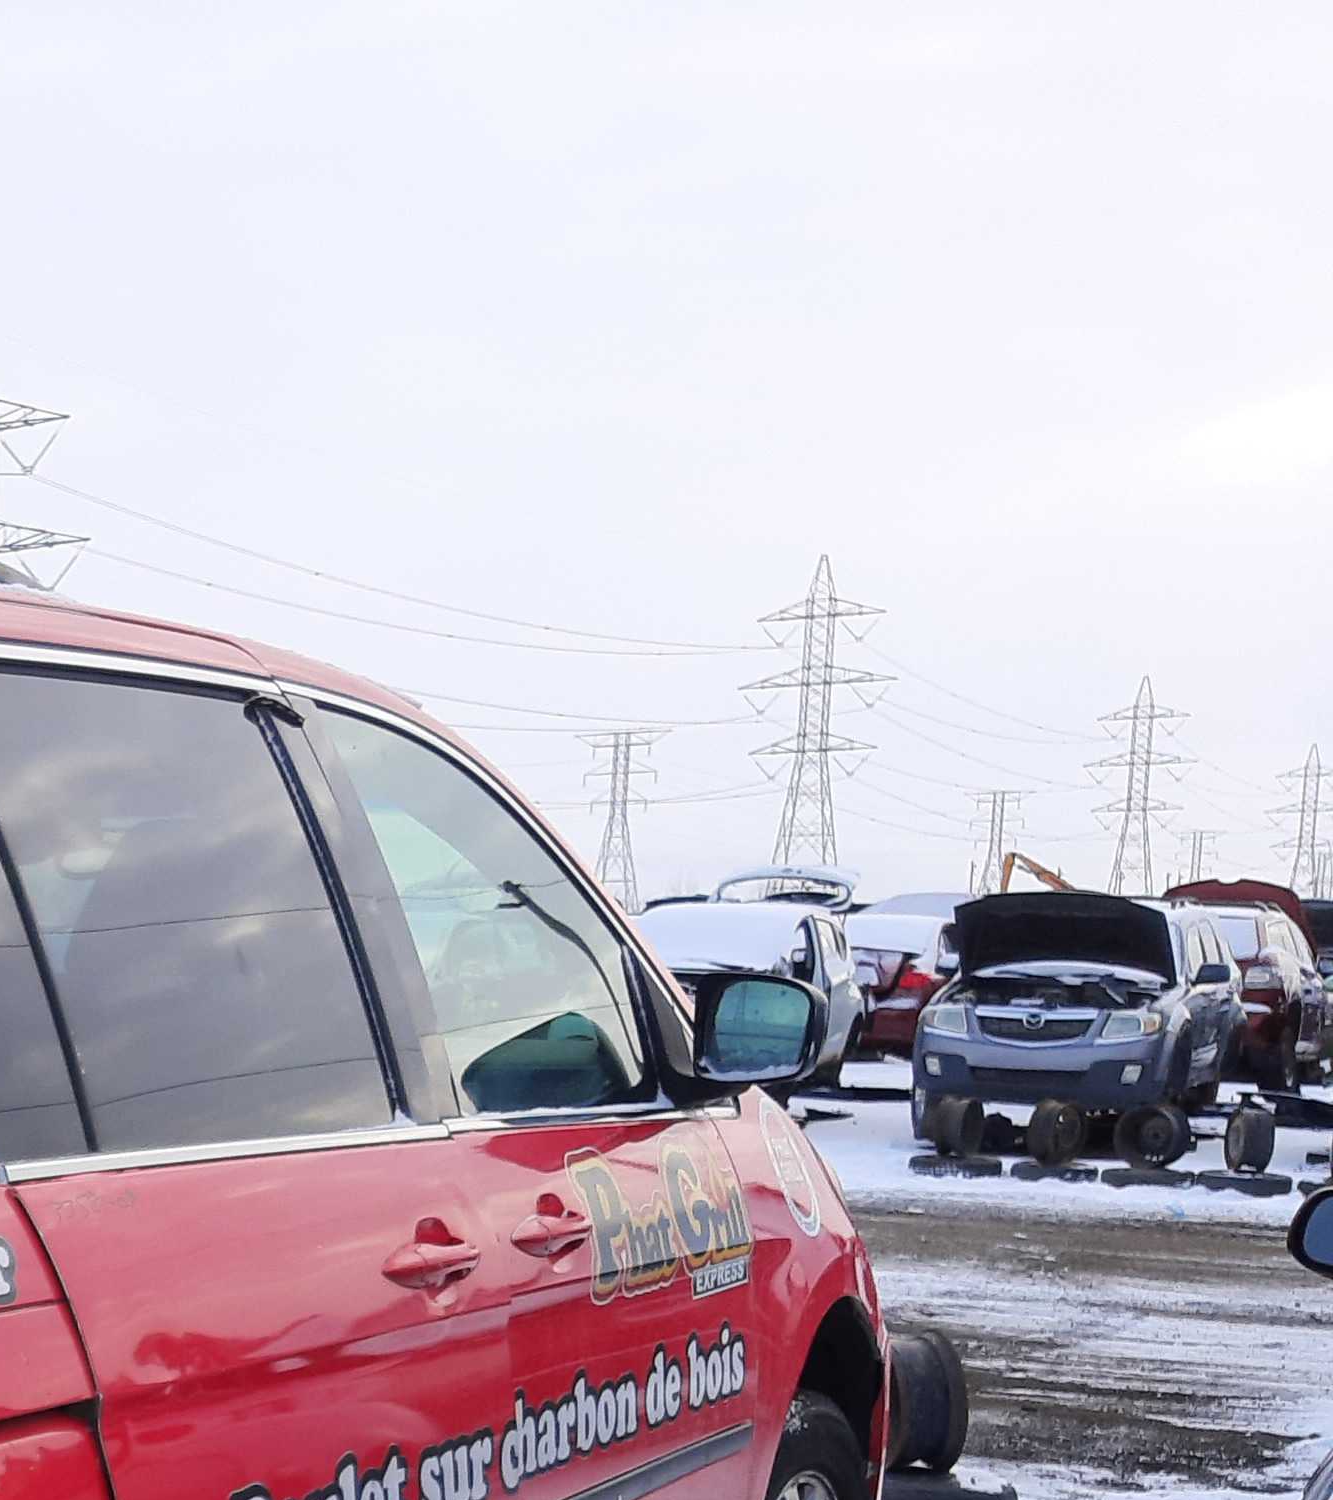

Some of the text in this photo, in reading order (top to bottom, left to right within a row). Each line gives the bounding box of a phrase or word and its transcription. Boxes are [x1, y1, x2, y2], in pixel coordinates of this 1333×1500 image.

[695, 1260, 745, 1292] EXPRESS
[501, 1373, 639, 1492] charbon
[645, 1345, 682, 1426] de
[687, 1324, 746, 1408] bois
